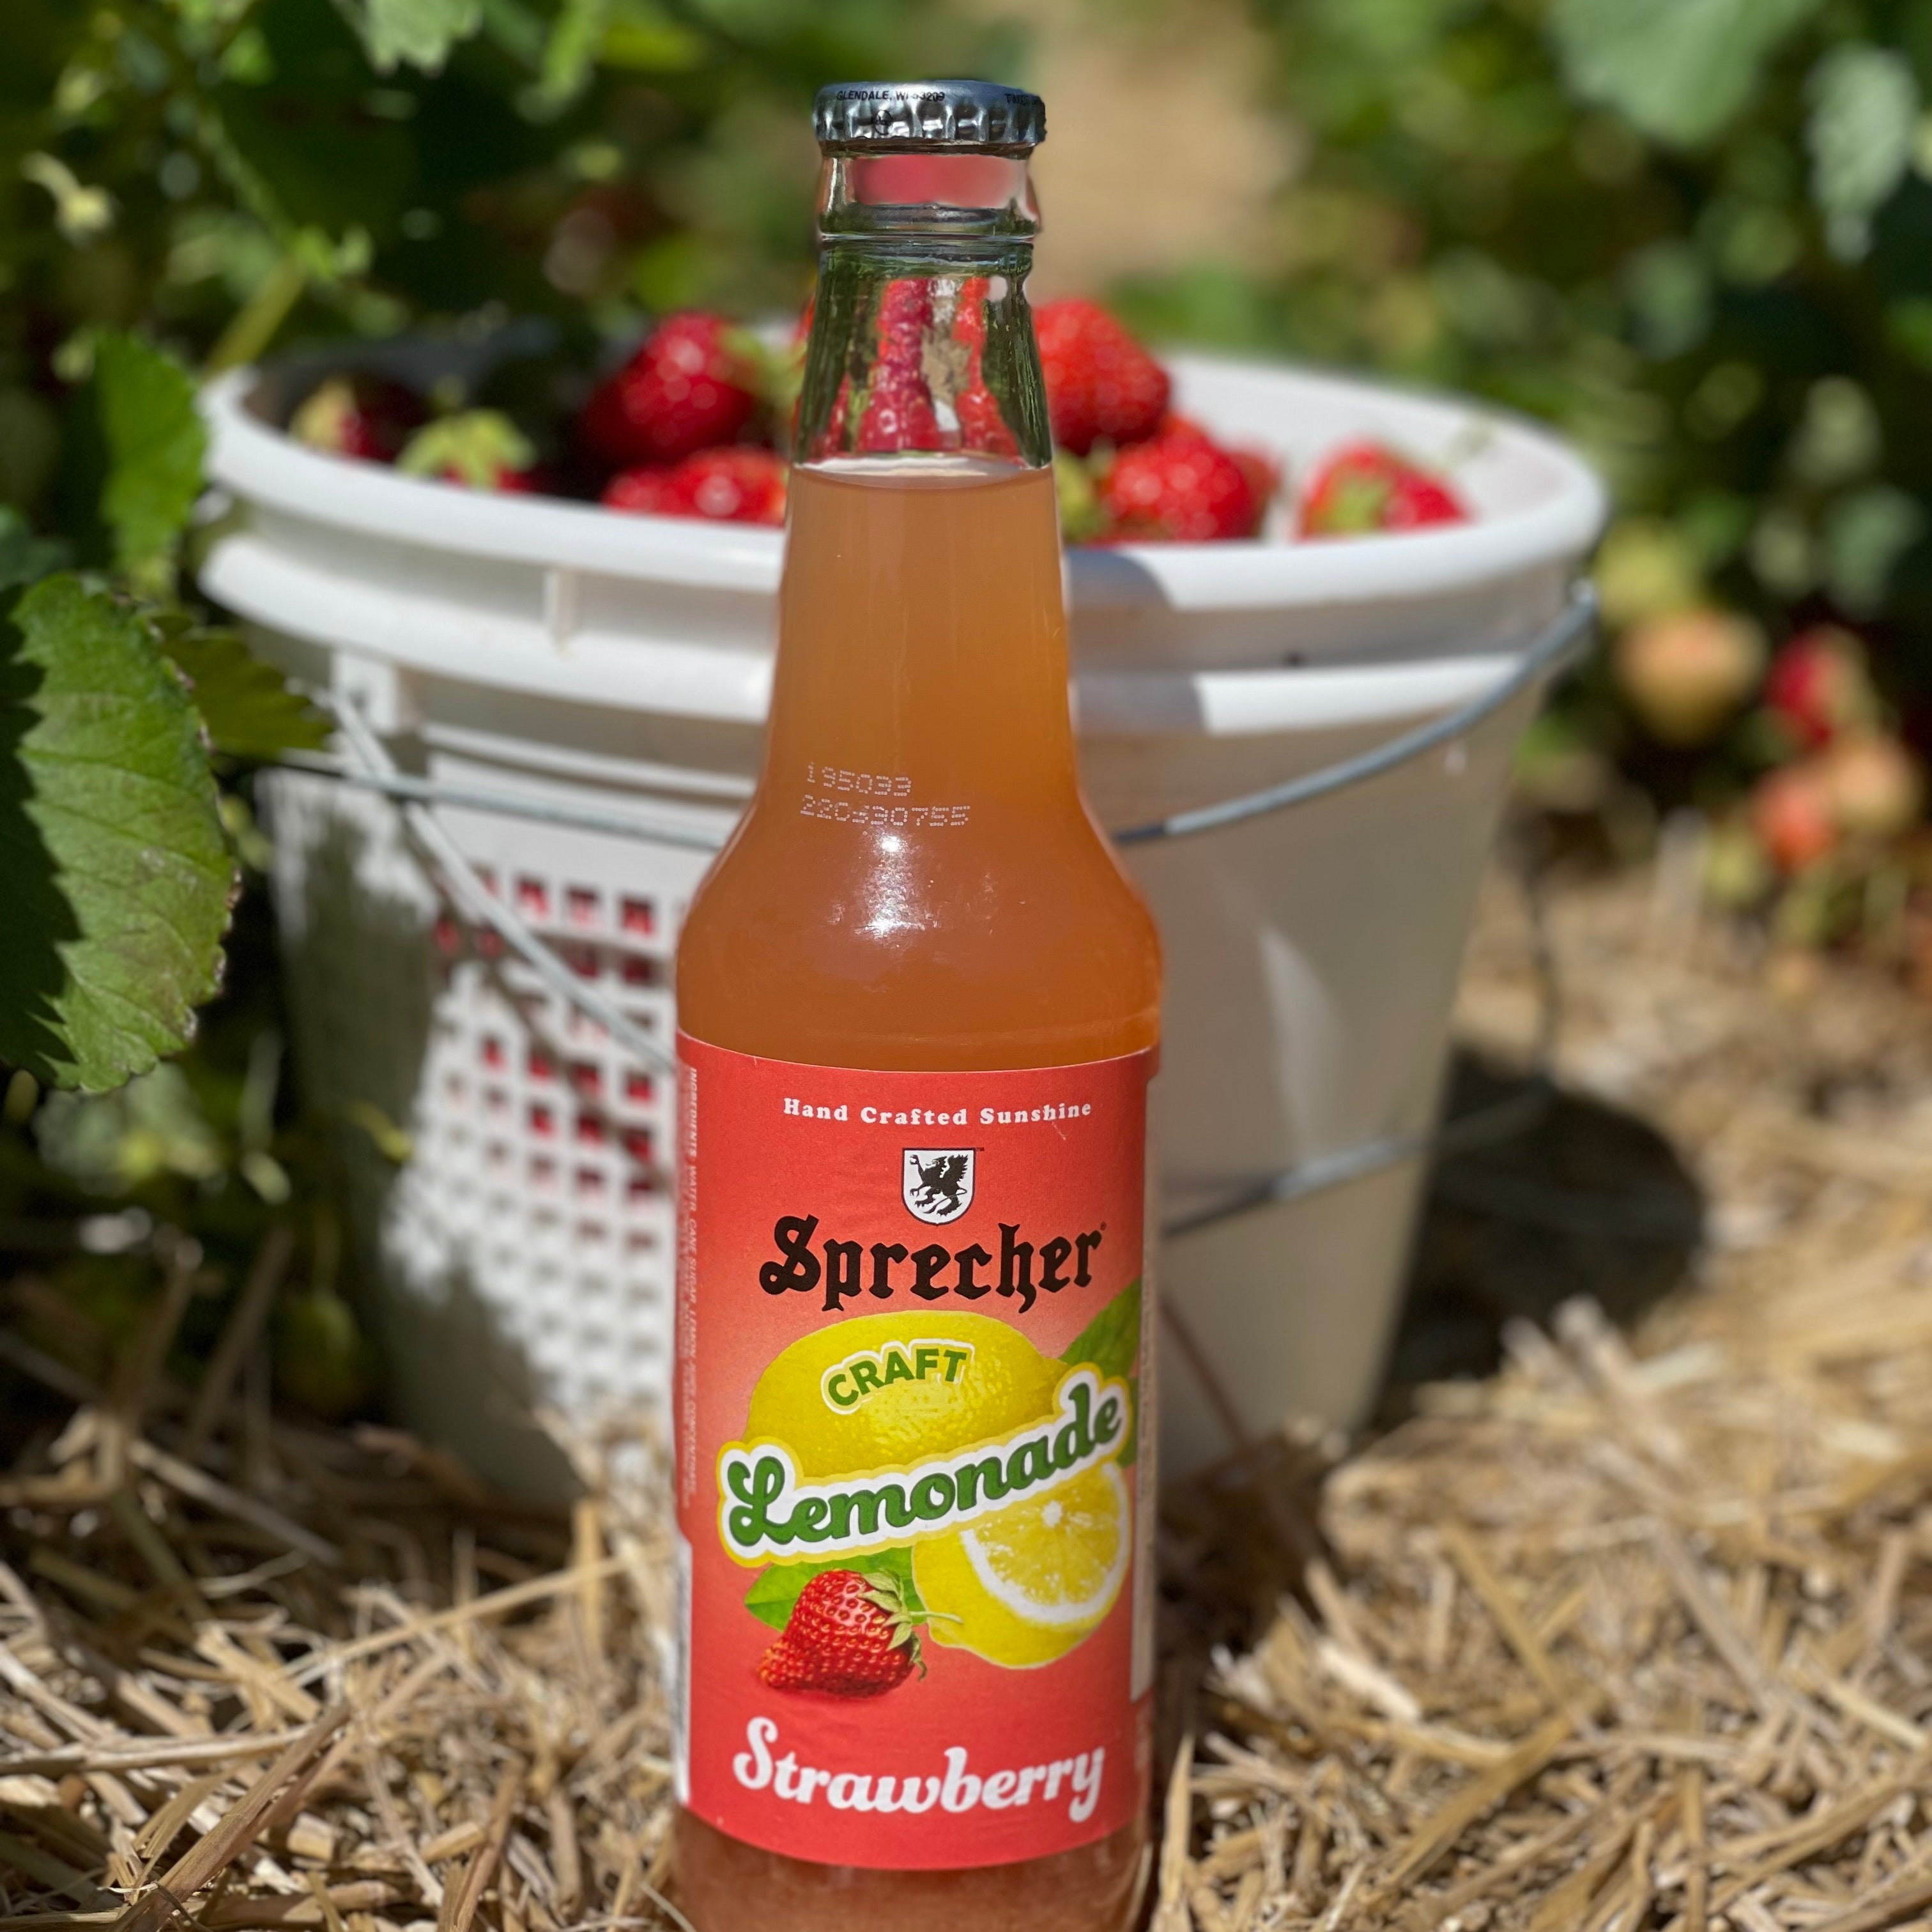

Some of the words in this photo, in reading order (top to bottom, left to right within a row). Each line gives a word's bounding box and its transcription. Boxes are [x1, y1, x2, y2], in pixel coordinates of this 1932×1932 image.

[784, 1098, 849, 1122] Hand
[861, 1107, 968, 1126] Crafted
[980, 1100, 1092, 1124] Sunshine
[759, 1214, 1103, 1314] Sprecher
[827, 1348, 967, 1406] CRAFT
[727, 1382, 1122, 1547] Lemonade
[732, 1716, 1106, 1823] Strawberry
